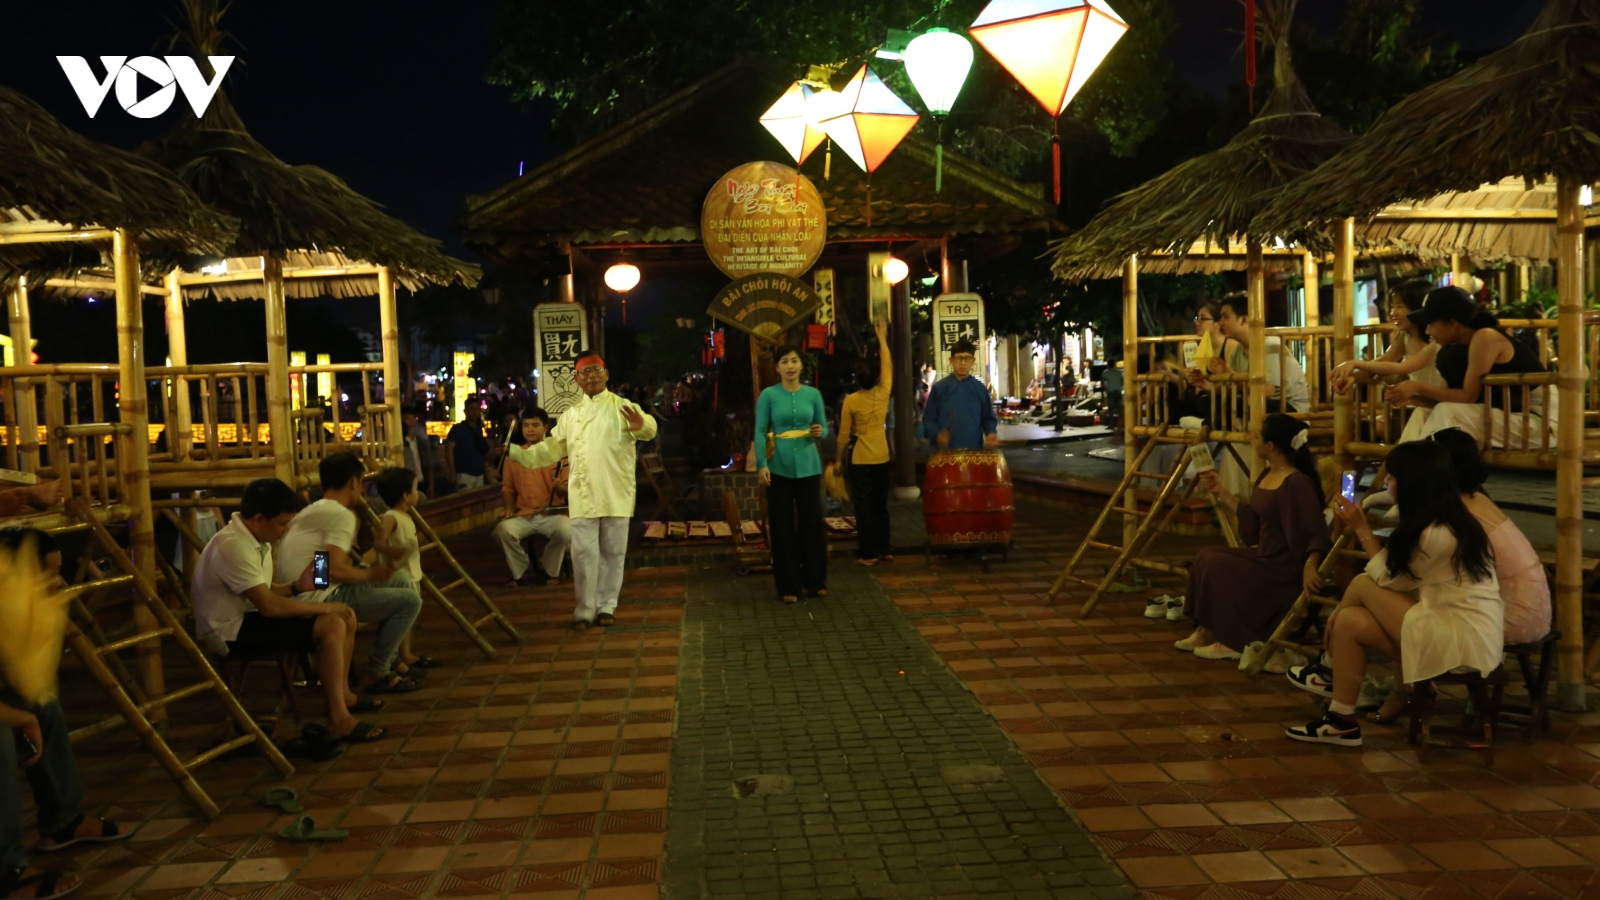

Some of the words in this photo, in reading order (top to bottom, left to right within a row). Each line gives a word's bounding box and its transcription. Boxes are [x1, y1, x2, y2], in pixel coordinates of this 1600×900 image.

[710, 220, 718, 229] DI
[772, 218, 785, 228] PHI
[759, 262, 769, 270] OF
[769, 262, 804, 270] HUMANITY
[721, 289, 742, 307] BÀI
[742, 277, 769, 294] CHÒI
[771, 278, 792, 294] HỘI
[792, 287, 809, 302] AN
[946, 303, 971, 314] TRÒ
